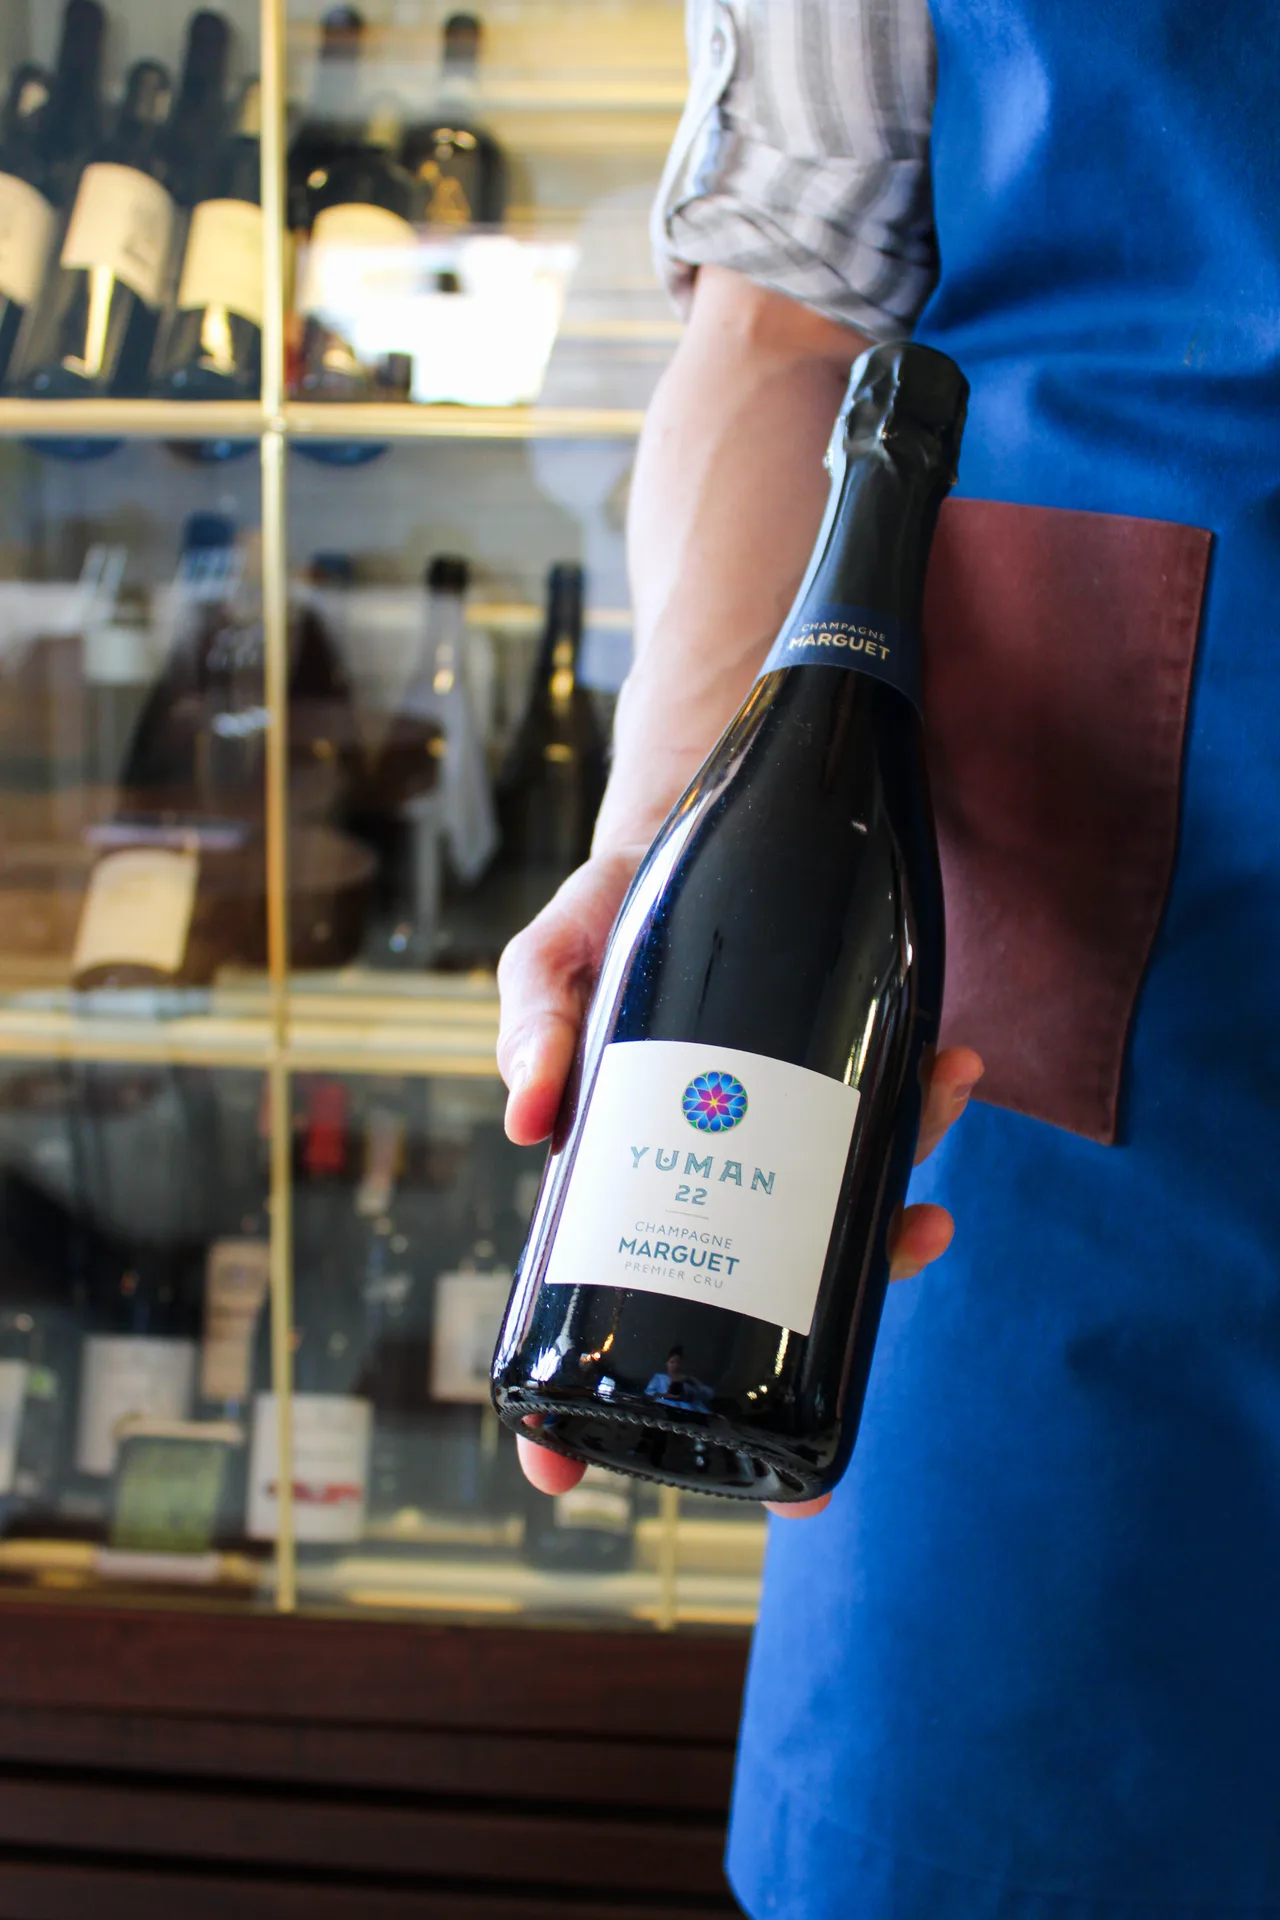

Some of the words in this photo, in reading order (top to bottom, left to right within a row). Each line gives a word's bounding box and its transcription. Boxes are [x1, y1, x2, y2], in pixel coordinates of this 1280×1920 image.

[801, 622, 886, 641] CHAMPAGNE
[788, 633, 890, 660] MARGUET
[630, 1146, 776, 1195] YUMAN
[674, 1184, 708, 1206] 22
[635, 1221, 733, 1249] CHAMPAGNE
[618, 1236, 740, 1276] MARGUET
[624, 1261, 685, 1280] PREMIER
[693, 1274, 724, 1289] CRU
